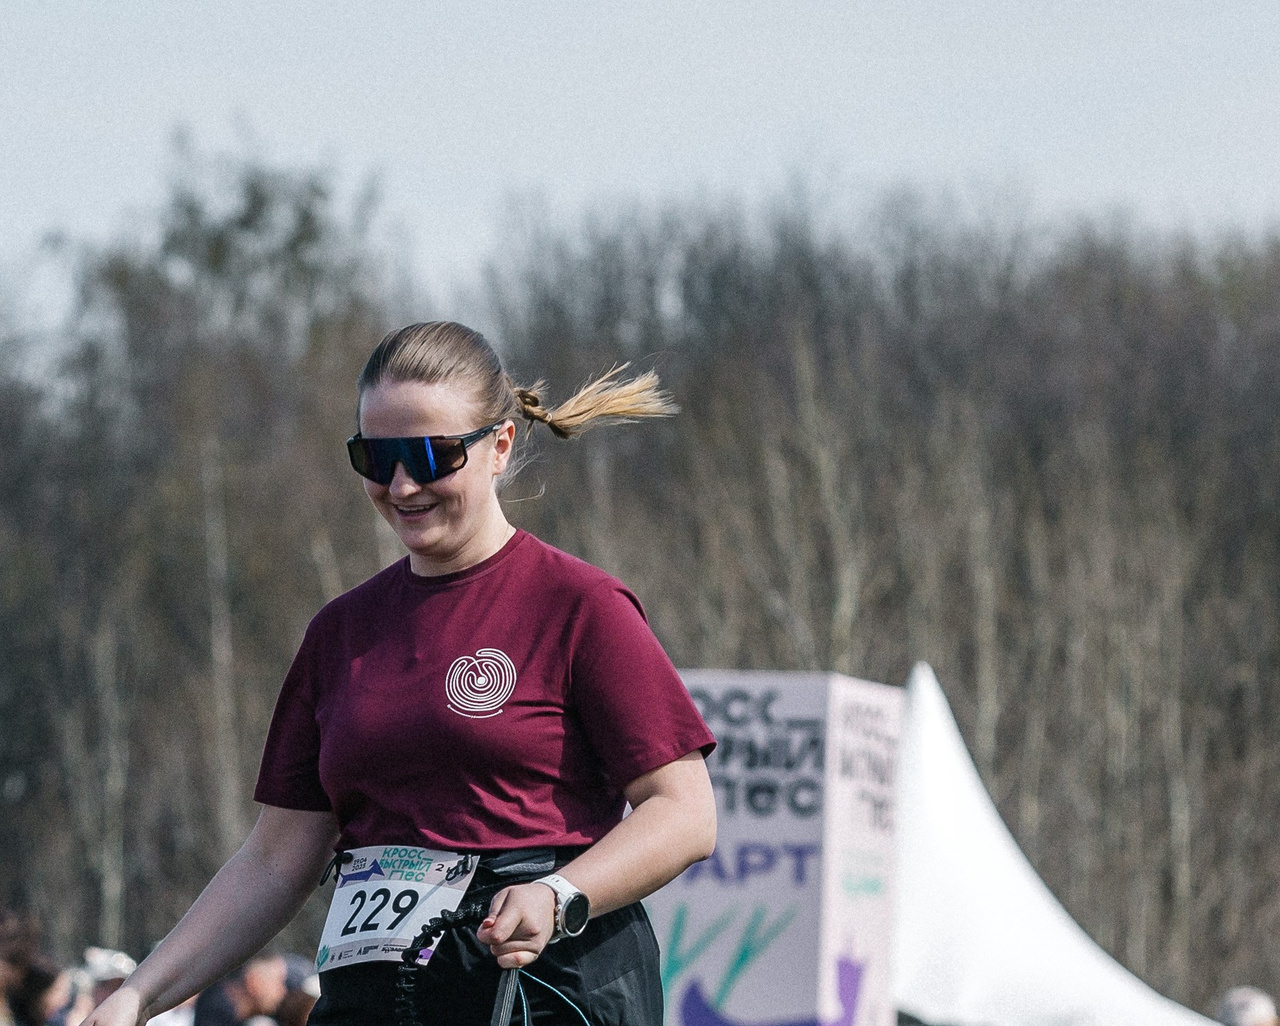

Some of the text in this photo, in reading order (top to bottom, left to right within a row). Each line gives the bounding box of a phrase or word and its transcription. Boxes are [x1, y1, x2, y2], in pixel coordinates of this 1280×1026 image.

[379, 857, 433, 872] БЫСТРЫЙ
[382, 847, 426, 859] КРОСС
[685, 843, 820, 884] АРТ
[340, 888, 420, 937] 229
